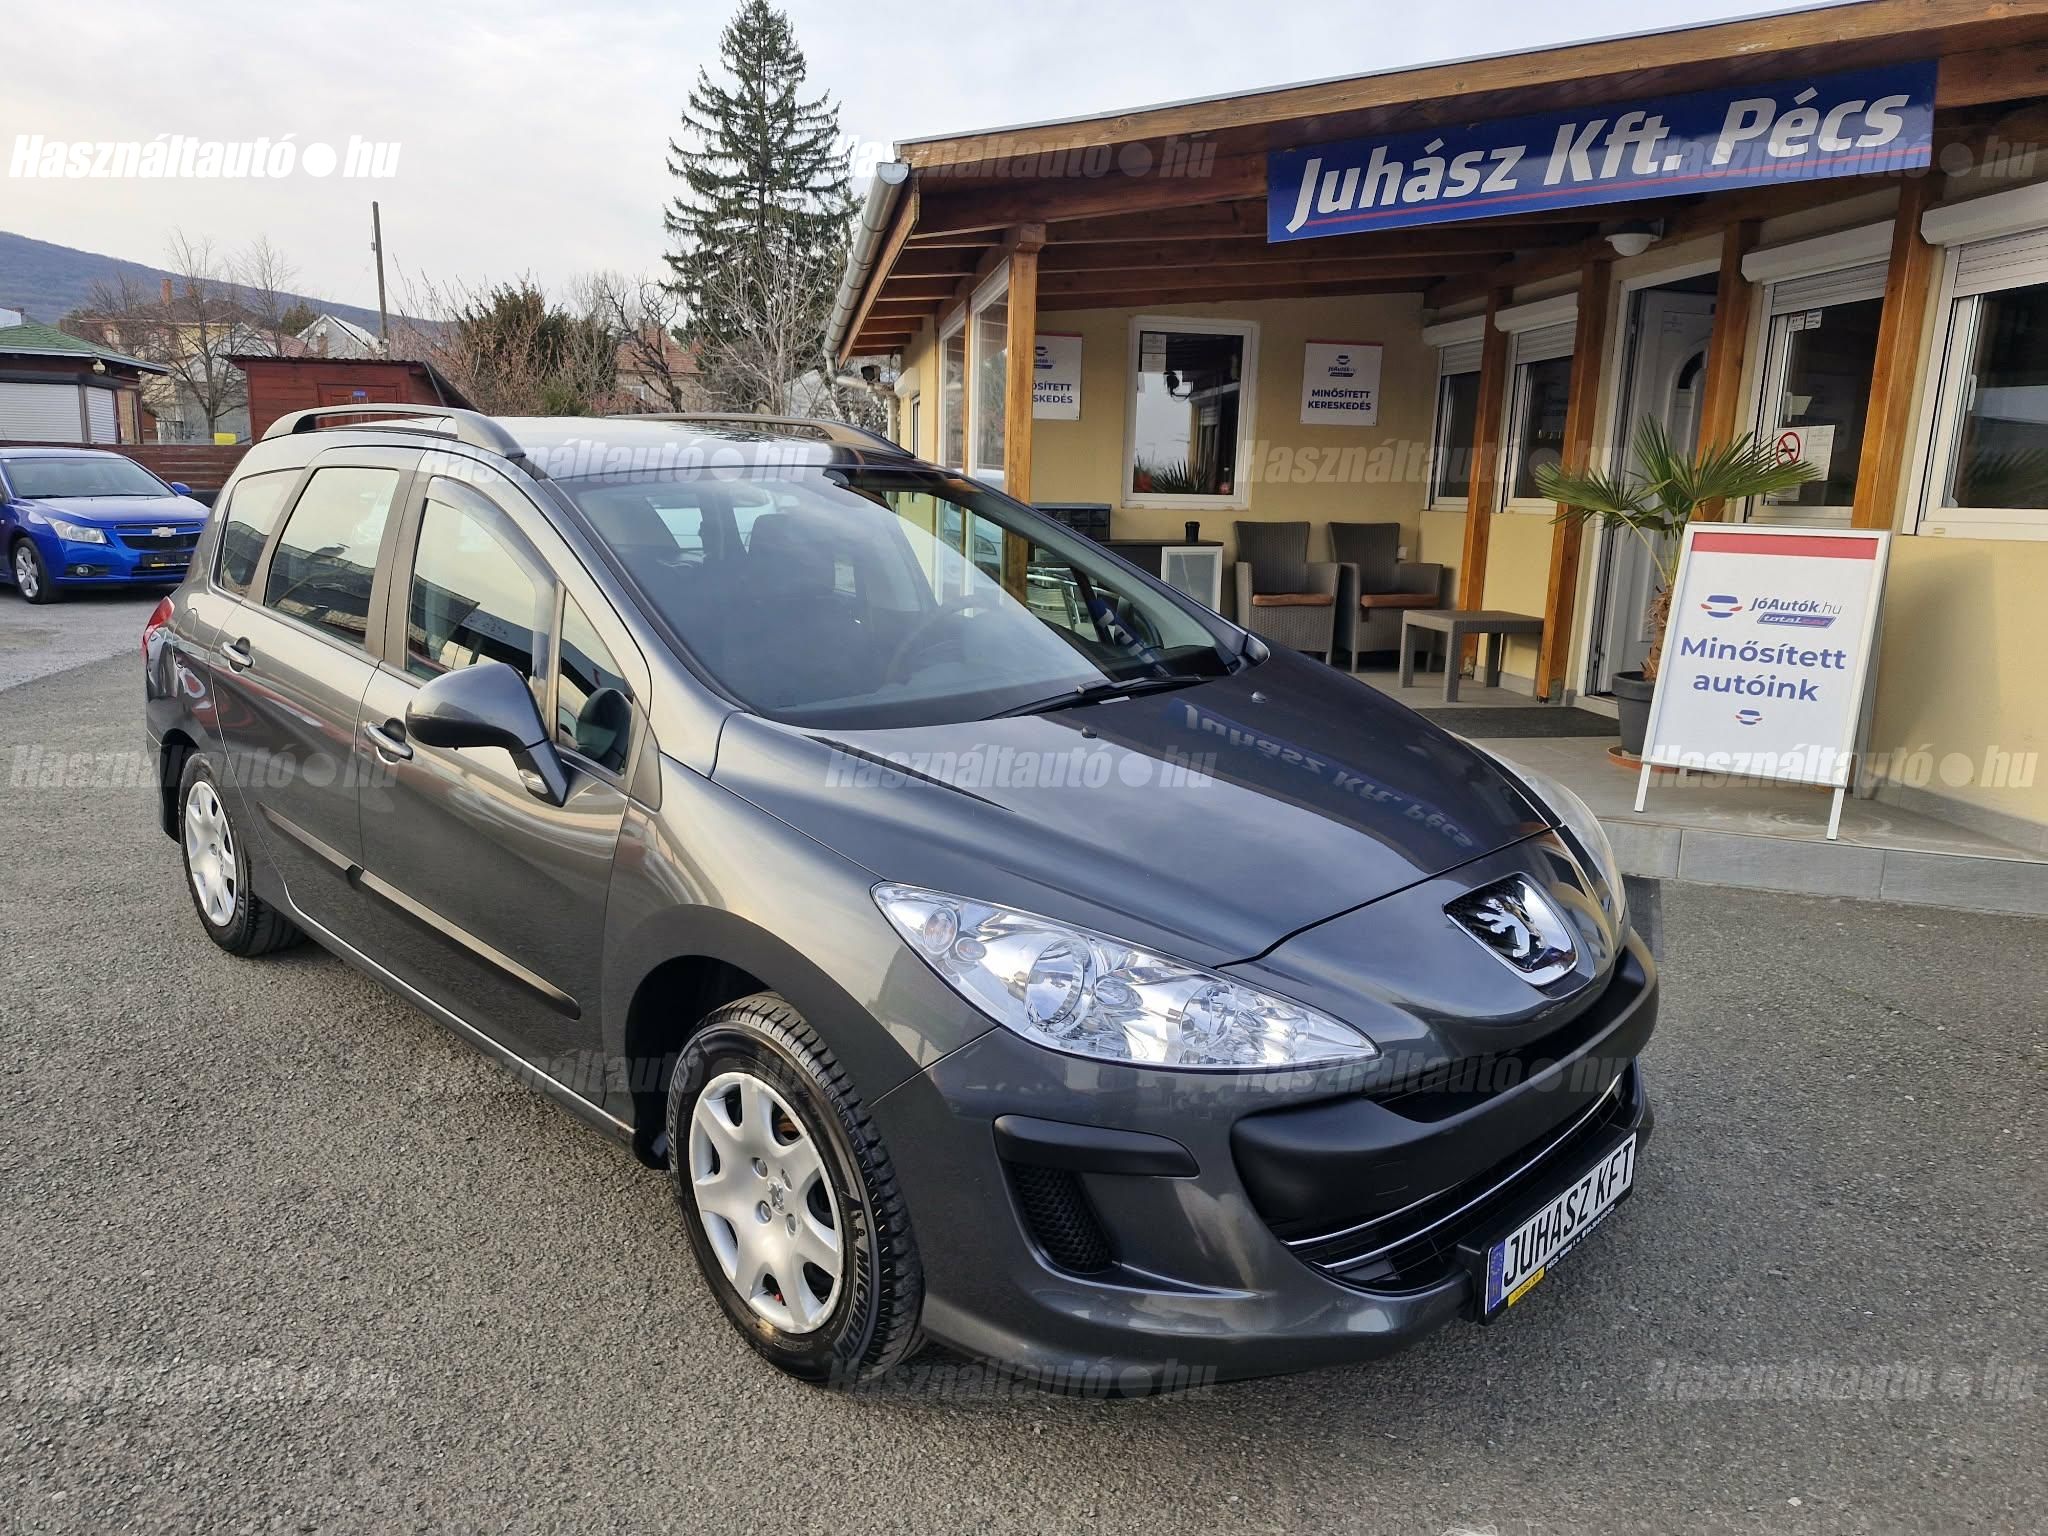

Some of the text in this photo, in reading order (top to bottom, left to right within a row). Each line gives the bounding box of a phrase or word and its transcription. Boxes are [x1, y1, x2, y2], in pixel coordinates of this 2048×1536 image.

[1287, 87, 1909, 233] Juhász Kft. Pécs
[1308, 400, 1372, 411] KERESKEDÉS
[1311, 387, 1371, 399] MINŐSÍTETT
[1749, 597, 1843, 615] JóAutók.hu
[1680, 636, 1847, 670] Minősített
[1693, 674, 1820, 702] autóink
[1503, 1180, 1592, 1288] JUHASZ
[1595, 1142, 1633, 1210] KFT
[833, 1247, 871, 1359] MICHELIN
